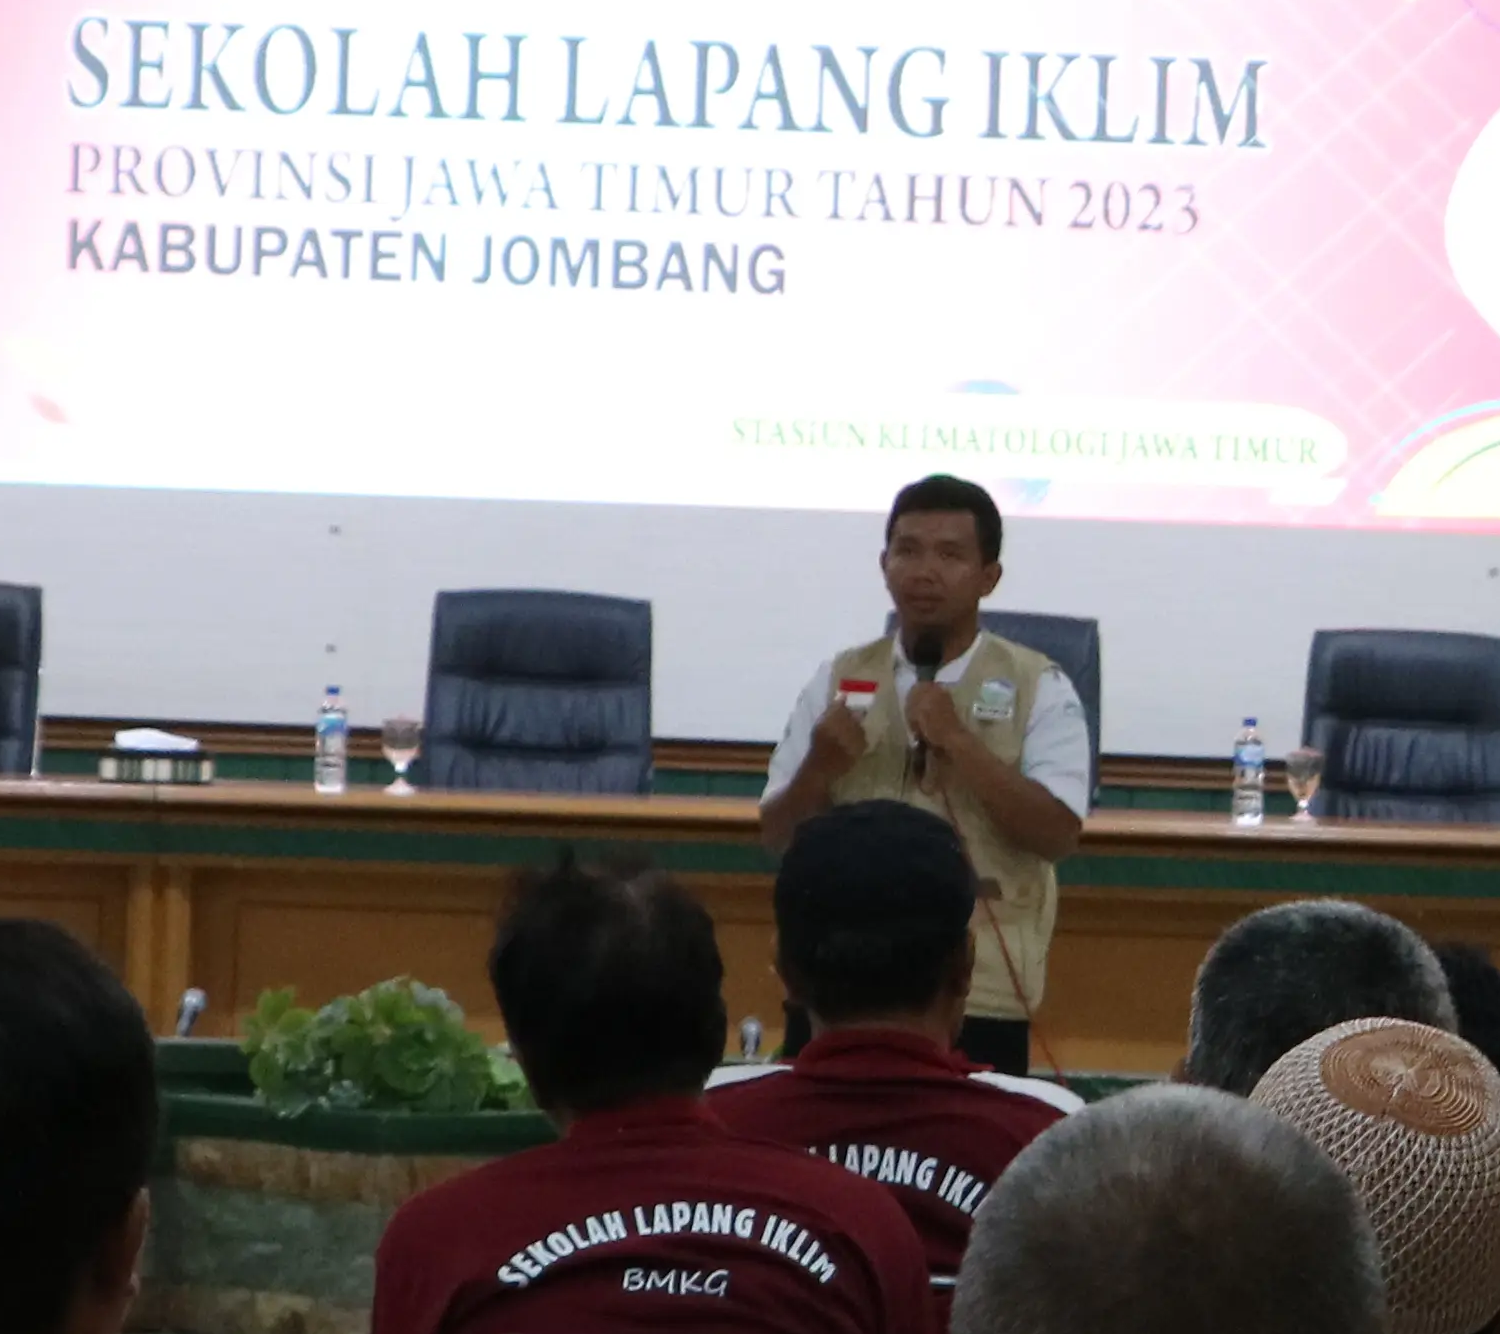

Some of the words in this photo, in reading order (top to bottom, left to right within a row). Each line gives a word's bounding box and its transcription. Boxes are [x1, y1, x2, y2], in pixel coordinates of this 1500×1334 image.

[67, 15, 530, 124] SEKOLAH
[556, 35, 950, 140] LAPANG
[979, 50, 1269, 149] IKLIM
[69, 143, 376, 204] PROVINSI
[391, 156, 558, 220] JAWA
[582, 162, 797, 218] TIMUR
[818, 169, 1046, 227] TAHUN
[1067, 180, 1199, 233] 2023
[69, 219, 448, 283] KABUPATEN
[471, 233, 786, 296] JOMBANG
[731, 418, 868, 448] STASIUN
[877, 423, 1108, 458] KLIMATOLOGI
[1115, 431, 1198, 465] JAWA
[1211, 434, 1318, 464] TIMUR
[937, 1165, 995, 1217] IKL
[497, 1210, 627, 1288] SEKOLAH
[634, 1201, 756, 1239] LAPANG
[760, 1214, 837, 1284] IKLIM
[621, 1267, 730, 1297] BMKG
